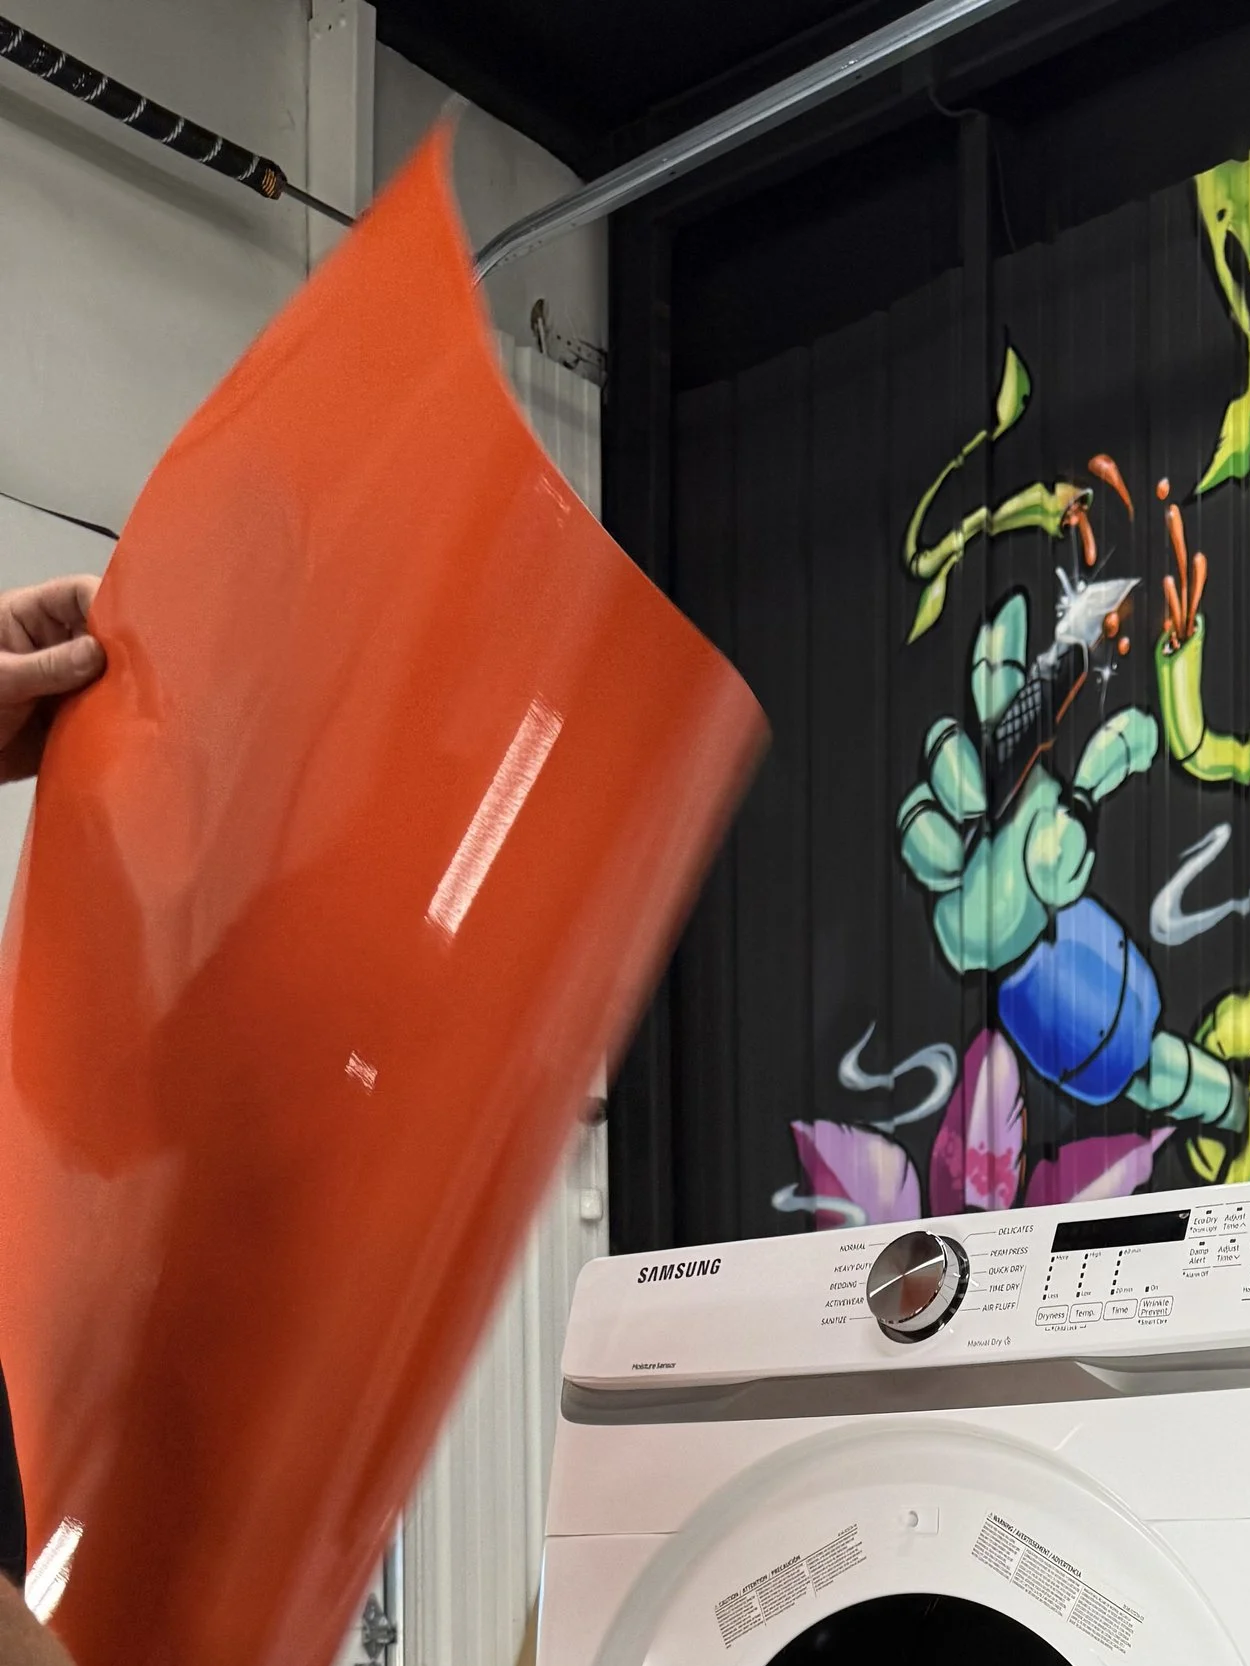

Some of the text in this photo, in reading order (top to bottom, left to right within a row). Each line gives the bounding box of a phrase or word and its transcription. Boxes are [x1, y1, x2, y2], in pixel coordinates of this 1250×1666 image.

[1194, 1216, 1218, 1225] Eco Dry
[1224, 1213, 1246, 1222] Adjust
[998, 1225, 1034, 1235] DELICATES
[1223, 1222, 1239, 1230] Time
[839, 1243, 866, 1252] NORMAL
[1008, 1247, 1028, 1256] PRESS
[1217, 1245, 1240, 1254] Adjust
[1190, 1248, 1209, 1257] Damp
[1188, 1256, 1206, 1264] Alert
[1217, 1254, 1233, 1262] Time
[637, 1258, 721, 1284] SAMSUNG
[834, 1264, 855, 1273] HEAVY
[988, 1264, 1024, 1276] QUICK DRY
[830, 1280, 858, 1290] BEDDING
[988, 1282, 1020, 1292] TIME DRY
[825, 1297, 864, 1308] ACTIVEWEAR
[982, 1302, 1016, 1312] AIR FLUFF
[1142, 1299, 1170, 1308] Wrinkle
[1075, 1310, 1094, 1318] Temp.
[1112, 1306, 1129, 1314] Time
[1140, 1308, 1168, 1316] Prevent
[820, 1316, 848, 1326] SANITIZE
[1038, 1312, 1065, 1321] Dryness
[967, 1338, 1003, 1348] Manual Dry
